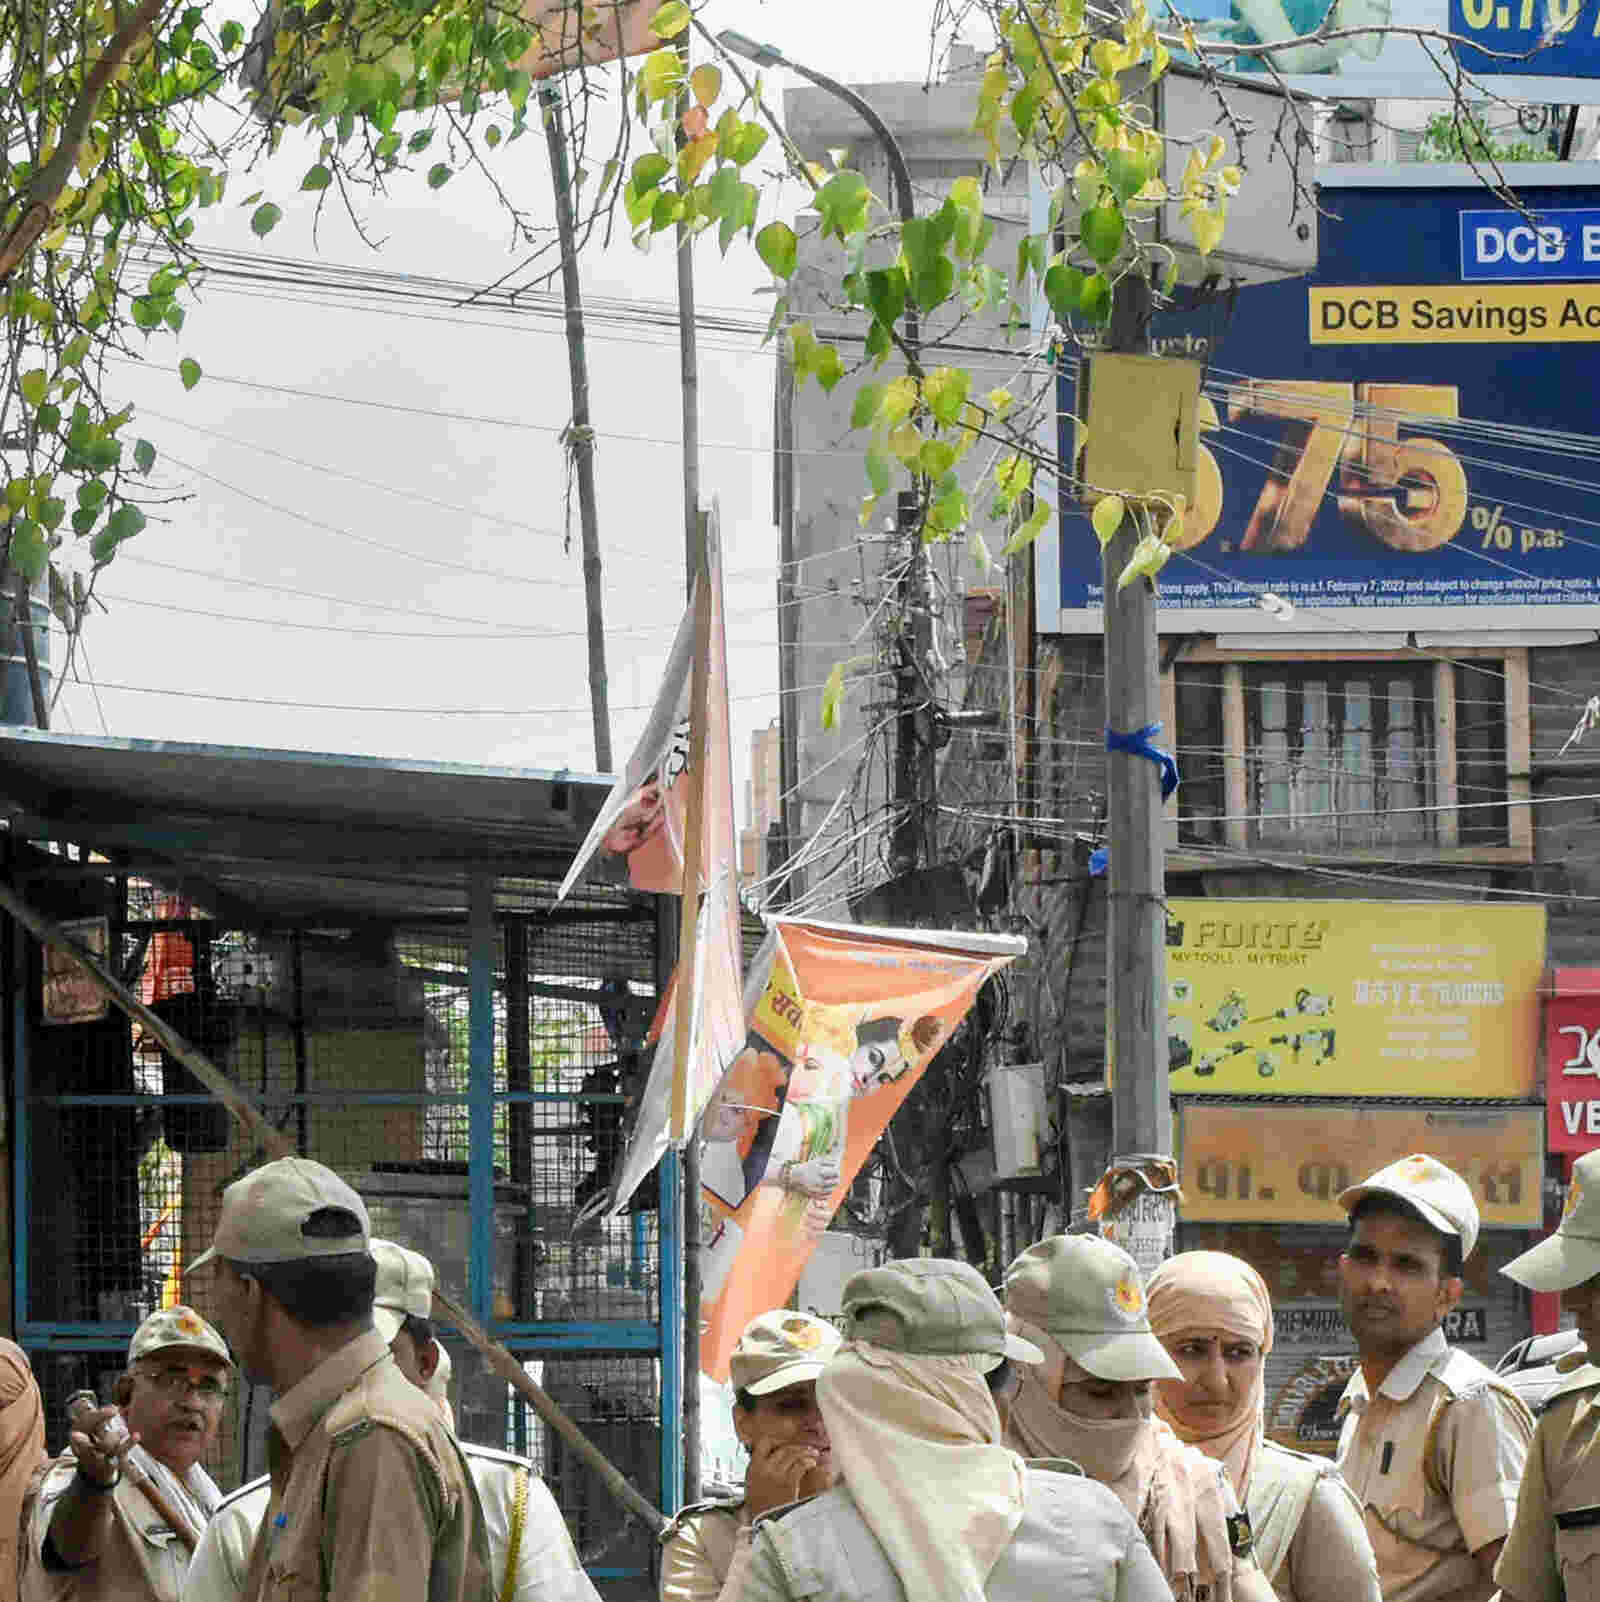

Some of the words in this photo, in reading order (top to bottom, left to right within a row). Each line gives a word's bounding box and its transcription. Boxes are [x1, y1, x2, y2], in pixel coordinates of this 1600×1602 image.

[1476, 225, 1565, 264] DCB
[1321, 300, 1399, 330] DCB
[1411, 299, 1548, 336] Savings
